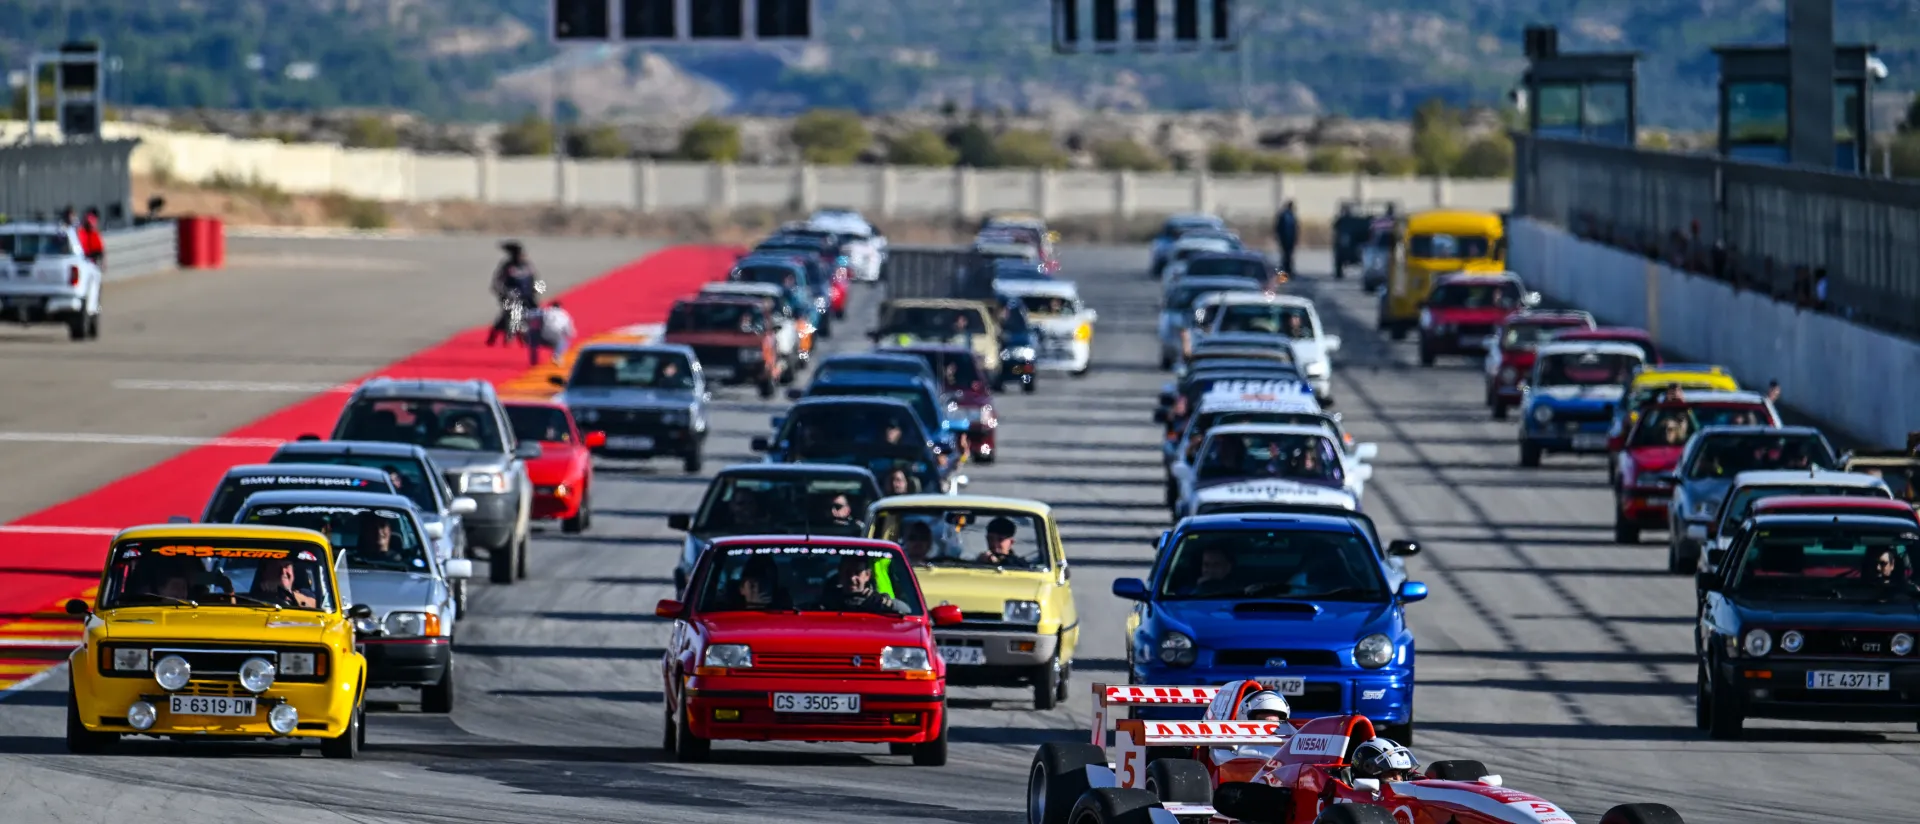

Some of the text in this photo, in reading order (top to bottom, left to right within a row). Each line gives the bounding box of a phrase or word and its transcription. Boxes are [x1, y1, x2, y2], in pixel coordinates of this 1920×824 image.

[277, 476, 351, 486] Motorsport
[1862, 643, 1880, 652] GTI
[1819, 673, 1886, 687] TE 4371 F
[1296, 738, 1328, 751] NISSAN
[1122, 751, 1137, 789] 5
[1530, 803, 1556, 814] 5
